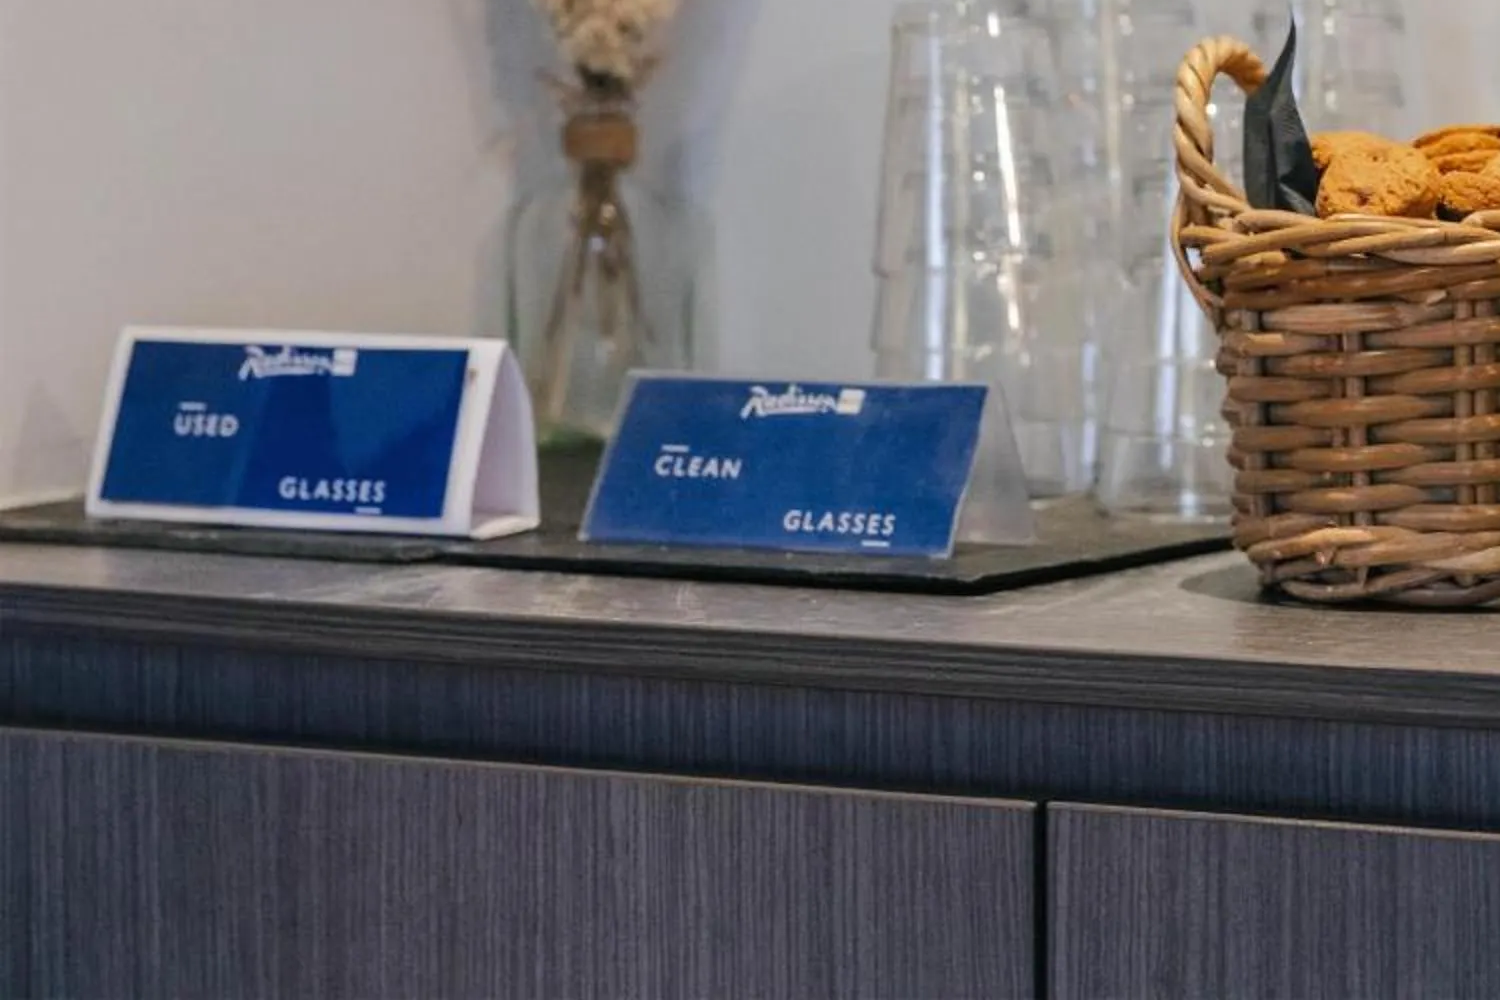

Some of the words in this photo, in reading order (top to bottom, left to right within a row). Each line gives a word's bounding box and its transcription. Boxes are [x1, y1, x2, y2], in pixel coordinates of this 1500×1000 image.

[174, 414, 240, 437] USED
[654, 456, 742, 479] CLEAN
[279, 477, 386, 502] GLASSES
[783, 510, 896, 536] GLASSES
